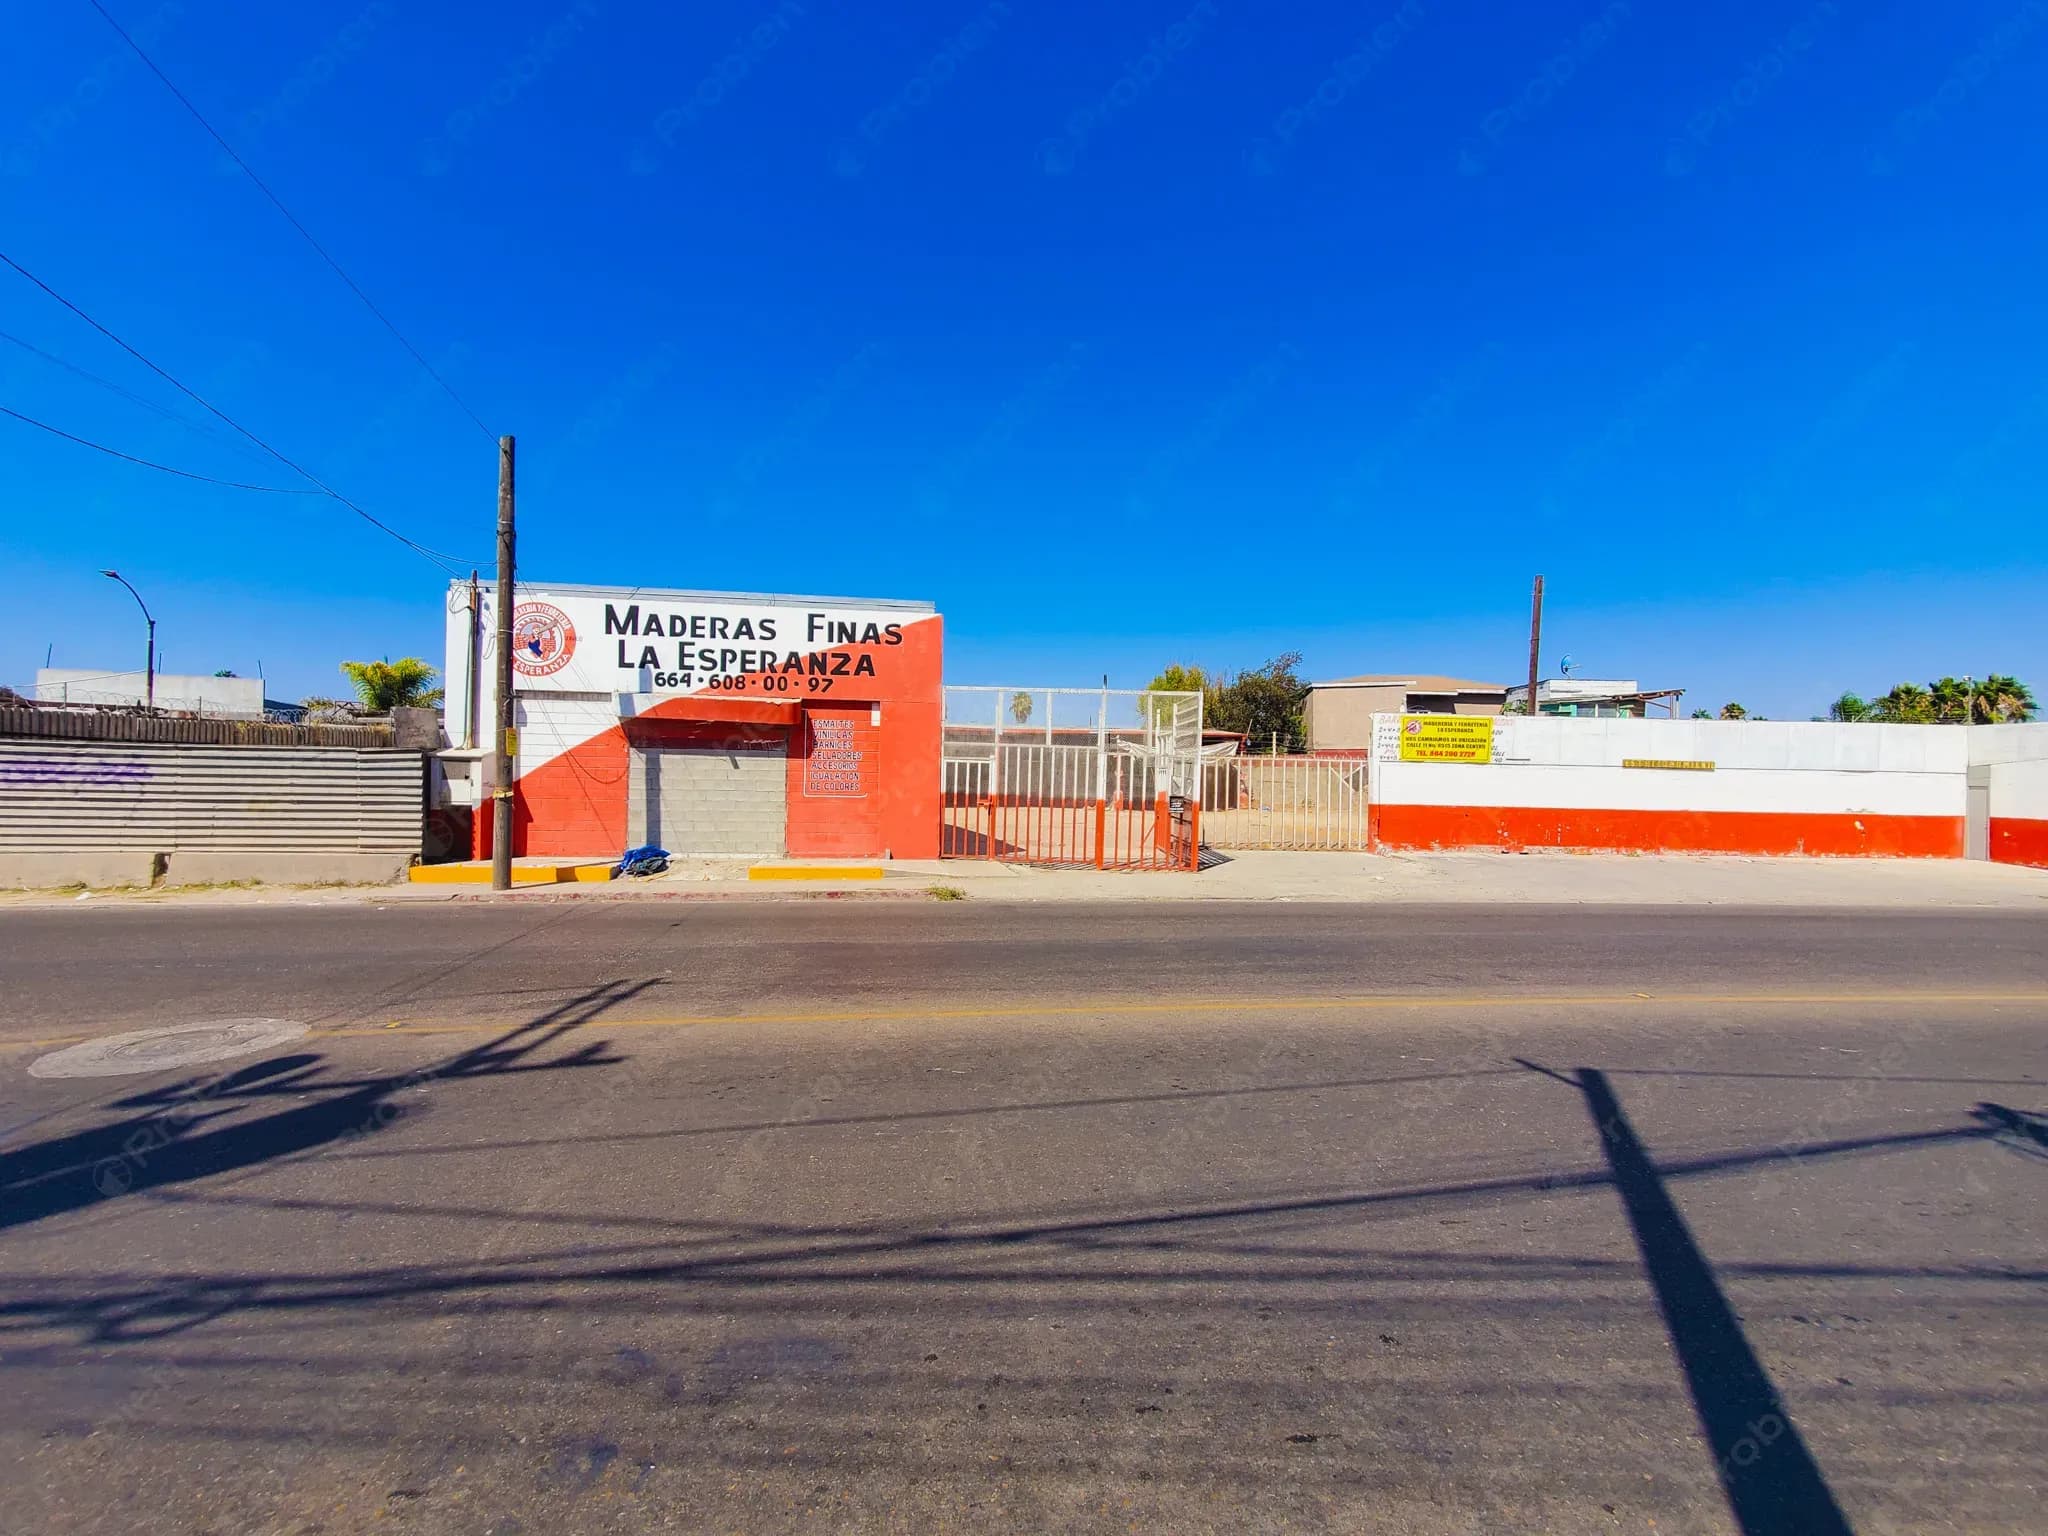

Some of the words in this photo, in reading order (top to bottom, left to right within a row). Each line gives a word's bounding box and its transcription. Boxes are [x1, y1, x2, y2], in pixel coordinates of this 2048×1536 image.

[605, 604, 776, 641] MADERAS
[807, 613, 902, 645] FINAS
[618, 639, 661, 669] LA
[678, 641, 876, 677] ESPERANZA
[514, 654, 570, 675] ESPERANZA
[813, 720, 854, 728] ESMALTES
[813, 741, 853, 749] BARNICES
[811, 752, 862, 760] SELLADORES
[811, 762, 857, 770] ACCESORIOS
[810, 782, 822, 791] DE
[824, 782, 860, 791] COLORES
